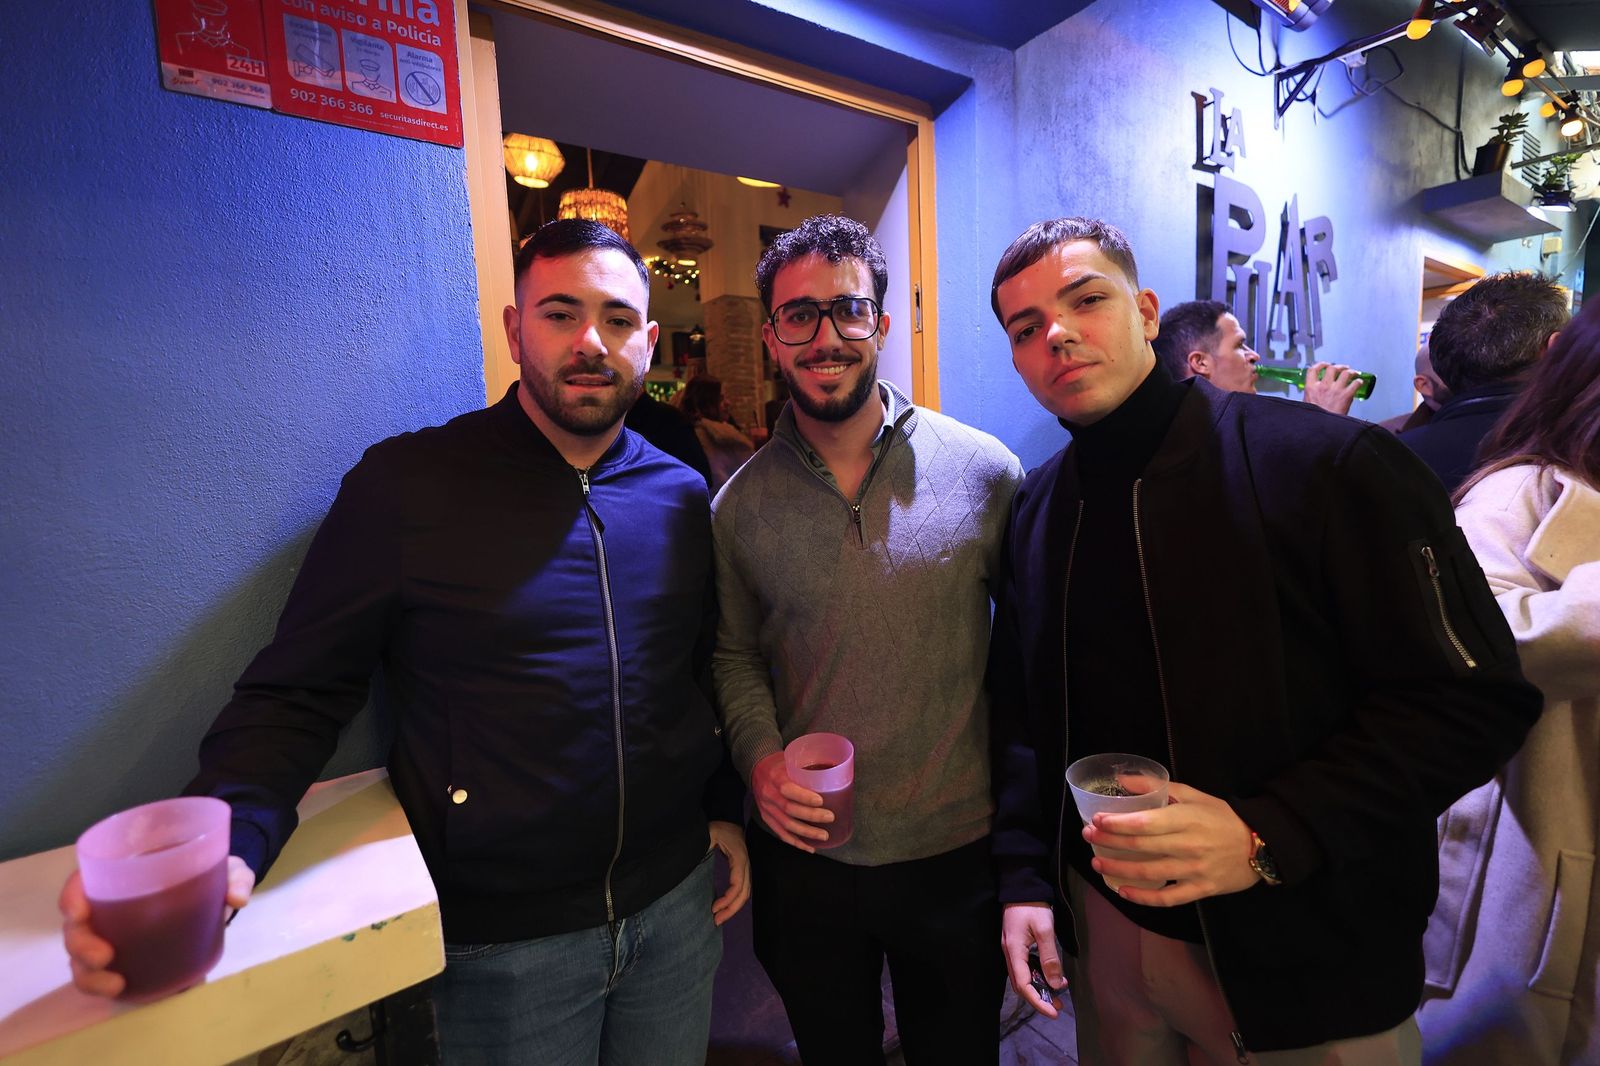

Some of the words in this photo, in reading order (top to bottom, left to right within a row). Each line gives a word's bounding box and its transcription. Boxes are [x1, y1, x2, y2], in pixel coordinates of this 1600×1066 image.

[320, 5, 367, 26] aviso
[372, 18, 381, 31] a
[387, 20, 441, 46] Policía
[228, 56, 263, 75] 24H
[407, 51, 433, 63] Alarma
[290, 88, 317, 103] 902
[320, 94, 346, 110] 366
[349, 100, 374, 115] 366
[380, 111, 449, 131] securitasdirect.es
[1206, 87, 1246, 172] LA
